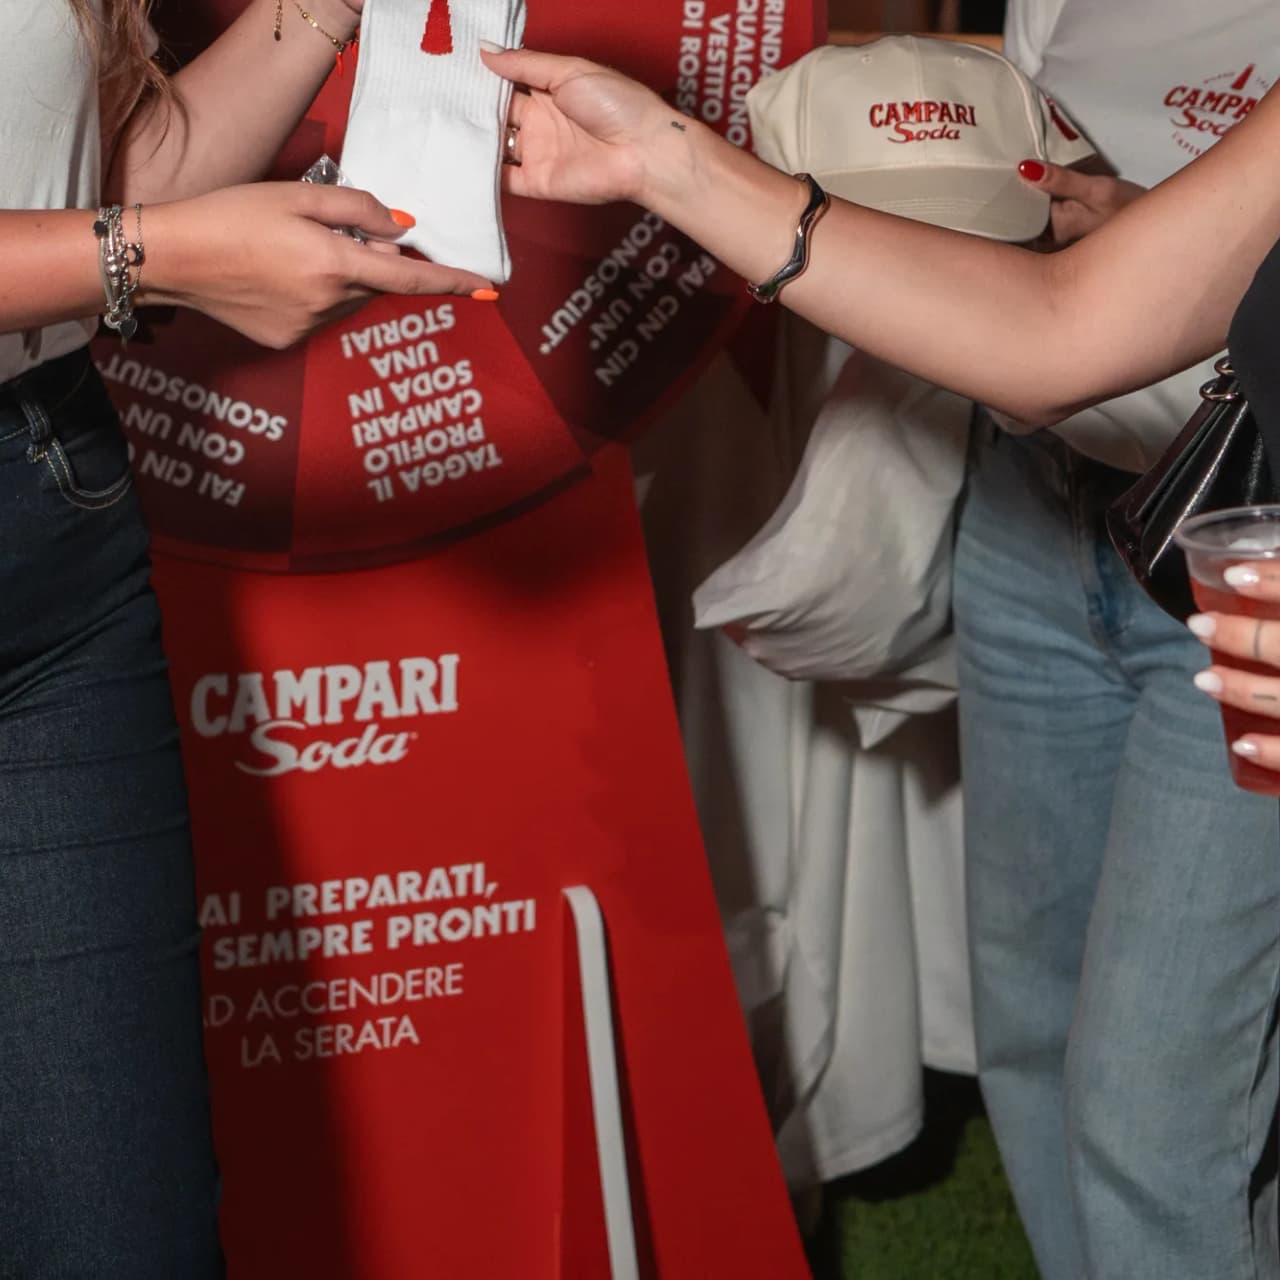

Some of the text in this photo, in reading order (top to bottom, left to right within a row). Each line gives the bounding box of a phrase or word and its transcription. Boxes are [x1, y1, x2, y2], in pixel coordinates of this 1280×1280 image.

[682, 0, 705, 29] DI
[701, 13, 732, 122] VESTITO
[868, 100, 978, 128] CAMPARI
[1163, 85, 1260, 120] CAMPA
[887, 121, 961, 144] Soda
[539, 212, 665, 354] CONOSCIUT
[627, 241, 681, 300] CON
[340, 303, 456, 359] STORIA!
[595, 254, 717, 387] FAI CIN CIN
[347, 359, 473, 418] SODA IN
[369, 340, 439, 379] UNA
[177, 422, 245, 465] CON
[351, 388, 483, 448] CAMPARI
[363, 417, 485, 474] PROFILO
[140, 450, 194, 487] CIN
[197, 471, 246, 507] FAI
[367, 443, 503, 502] TAGGA IL
[190, 653, 459, 738] CAMPARI
[234, 719, 410, 777] Soda
[199, 862, 497, 928] AI PREPARATI,
[213, 898, 536, 970] SEMPRE PRONTI
[203, 963, 464, 1028] D ACCENDERE
[241, 1014, 420, 1068] LA SERATA
